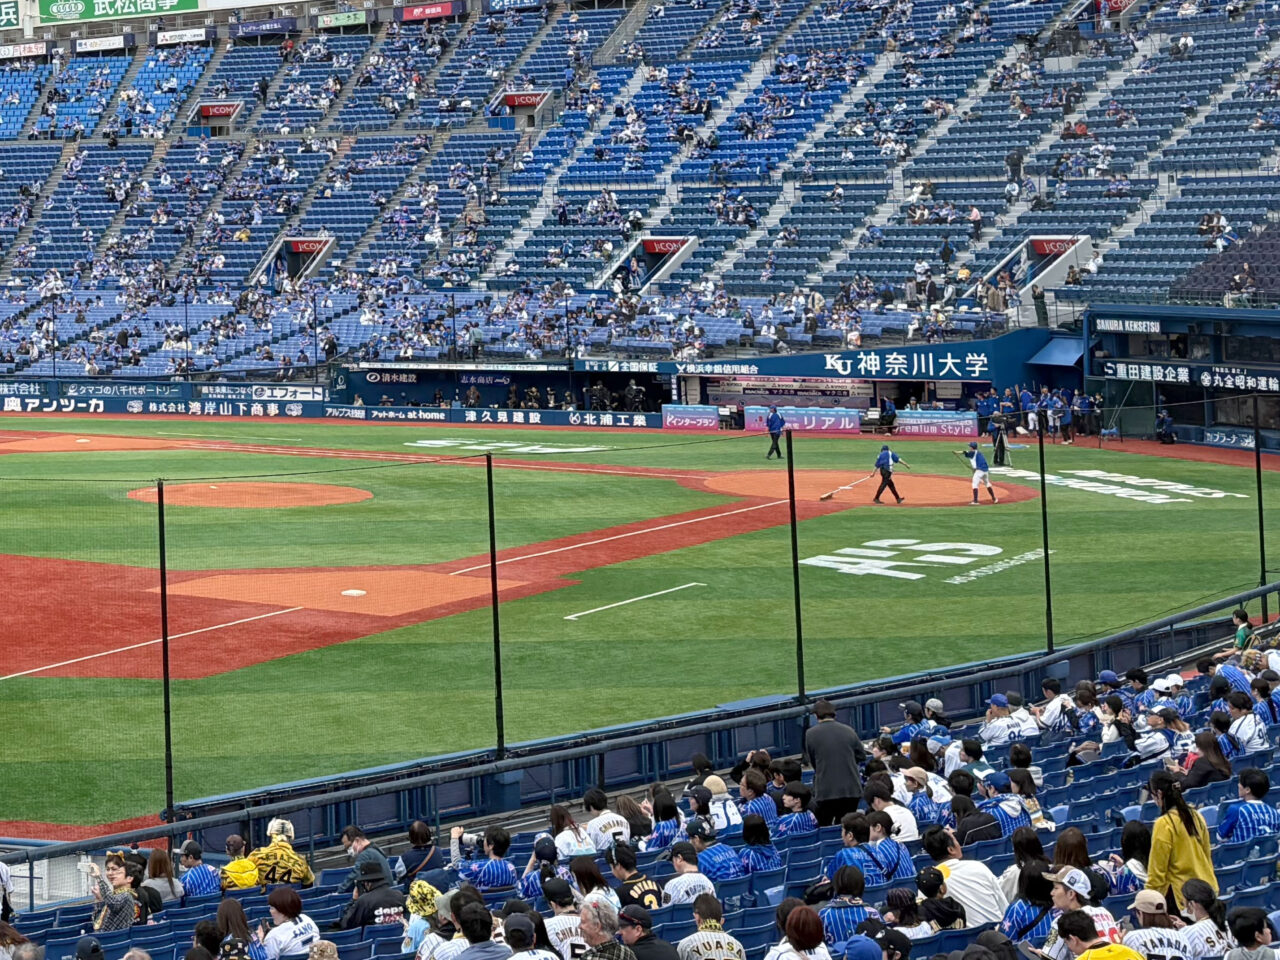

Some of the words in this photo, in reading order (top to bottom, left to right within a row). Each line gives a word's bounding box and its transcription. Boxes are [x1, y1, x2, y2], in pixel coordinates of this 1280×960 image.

[1096, 319, 1123, 332] SAKURA
[620, 361, 659, 373] 全国保証
[857, 351, 989, 377] 神奈川大学
[381, 373, 417, 383] 清水建設
[1116, 363, 1190, 383] 重田建設企業
[1213, 374, 1280, 391] 丸全昭和運輸
[266, 387, 322, 399] エフォート
[3, 397, 105, 413] 奥アンツーカ
[148, 402, 186, 413] 株式会社
[188, 400, 280, 417] 湾岸山下商事
[465, 410, 542, 424] 津久見建設
[583, 413, 647, 427] 北浦工業
[804, 416, 854, 430] リアル
[940, 424, 973, 436] Style
[265, 865, 292, 883] 44
[692, 940, 743, 960] YUASA
